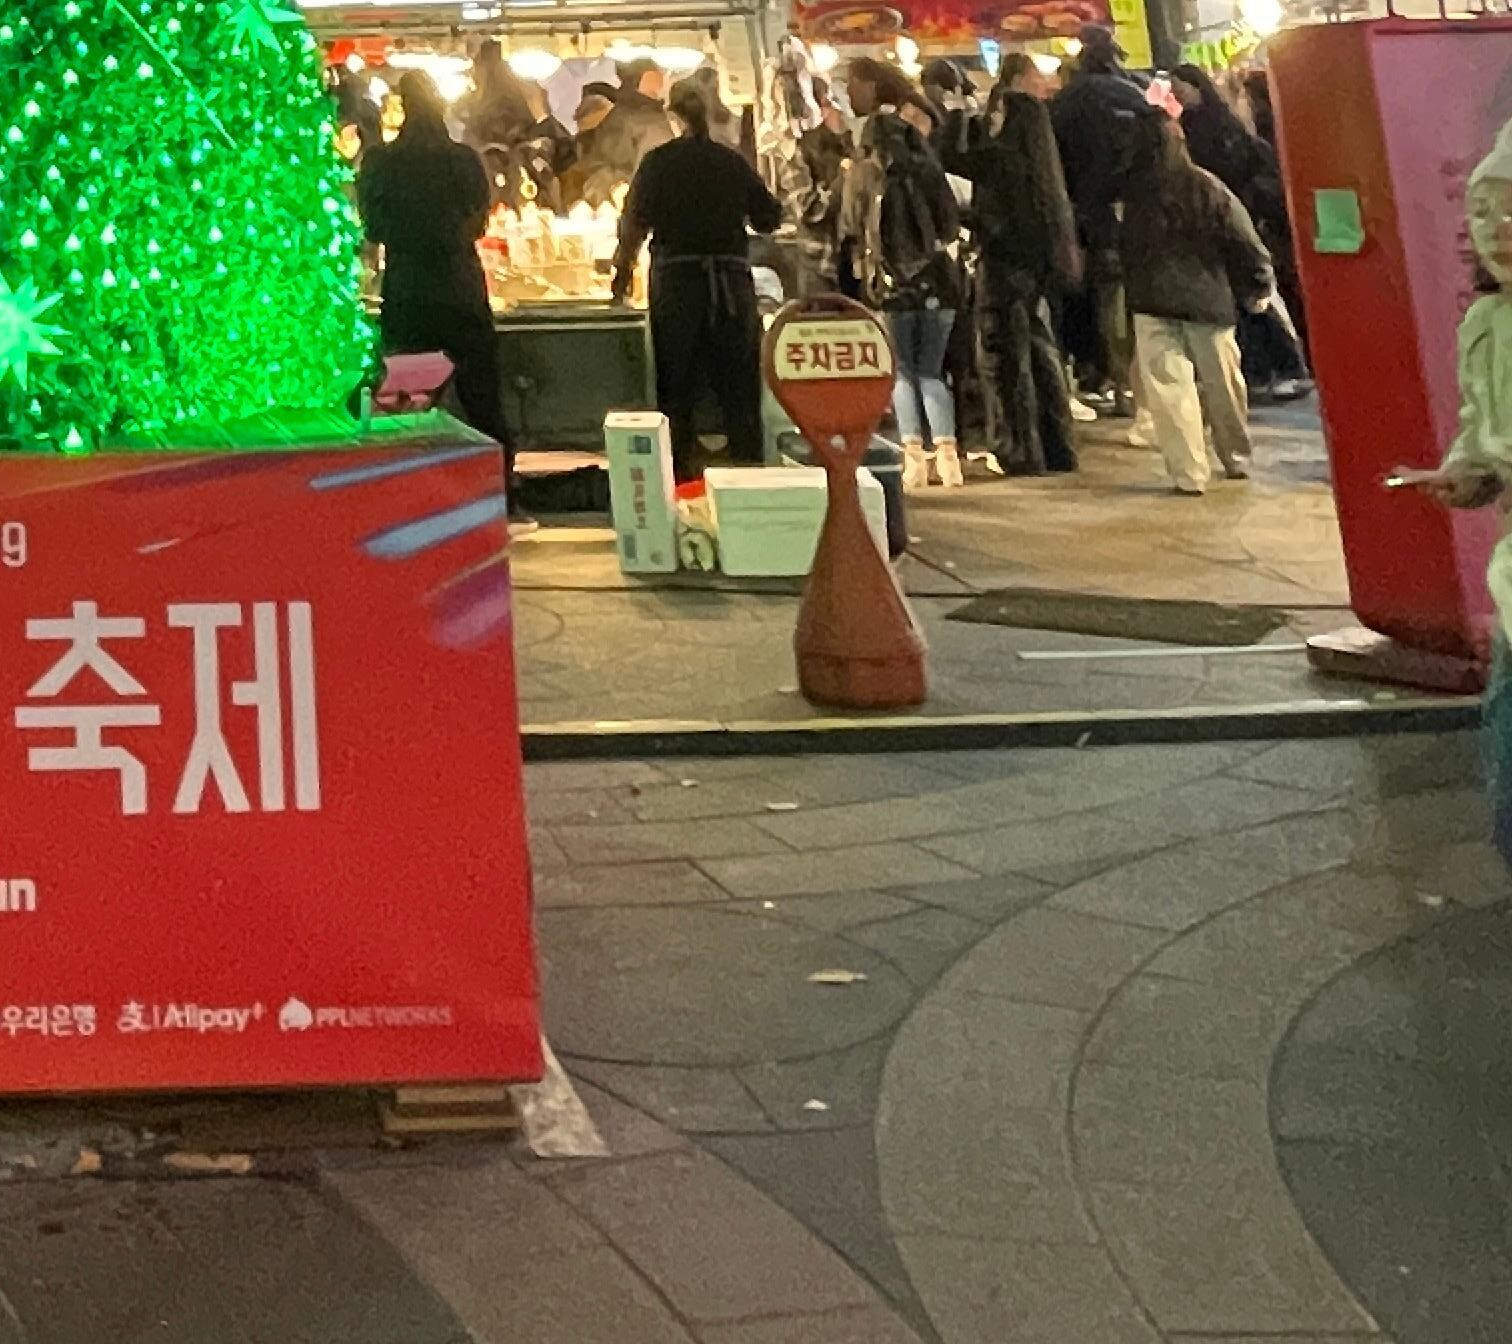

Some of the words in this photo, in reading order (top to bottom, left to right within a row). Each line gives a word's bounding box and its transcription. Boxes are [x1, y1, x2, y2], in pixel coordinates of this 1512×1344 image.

[786, 341, 880, 372] 주차금지
[14, 600, 322, 817] 축제
[0, 1005, 97, 1037] 우리은행
